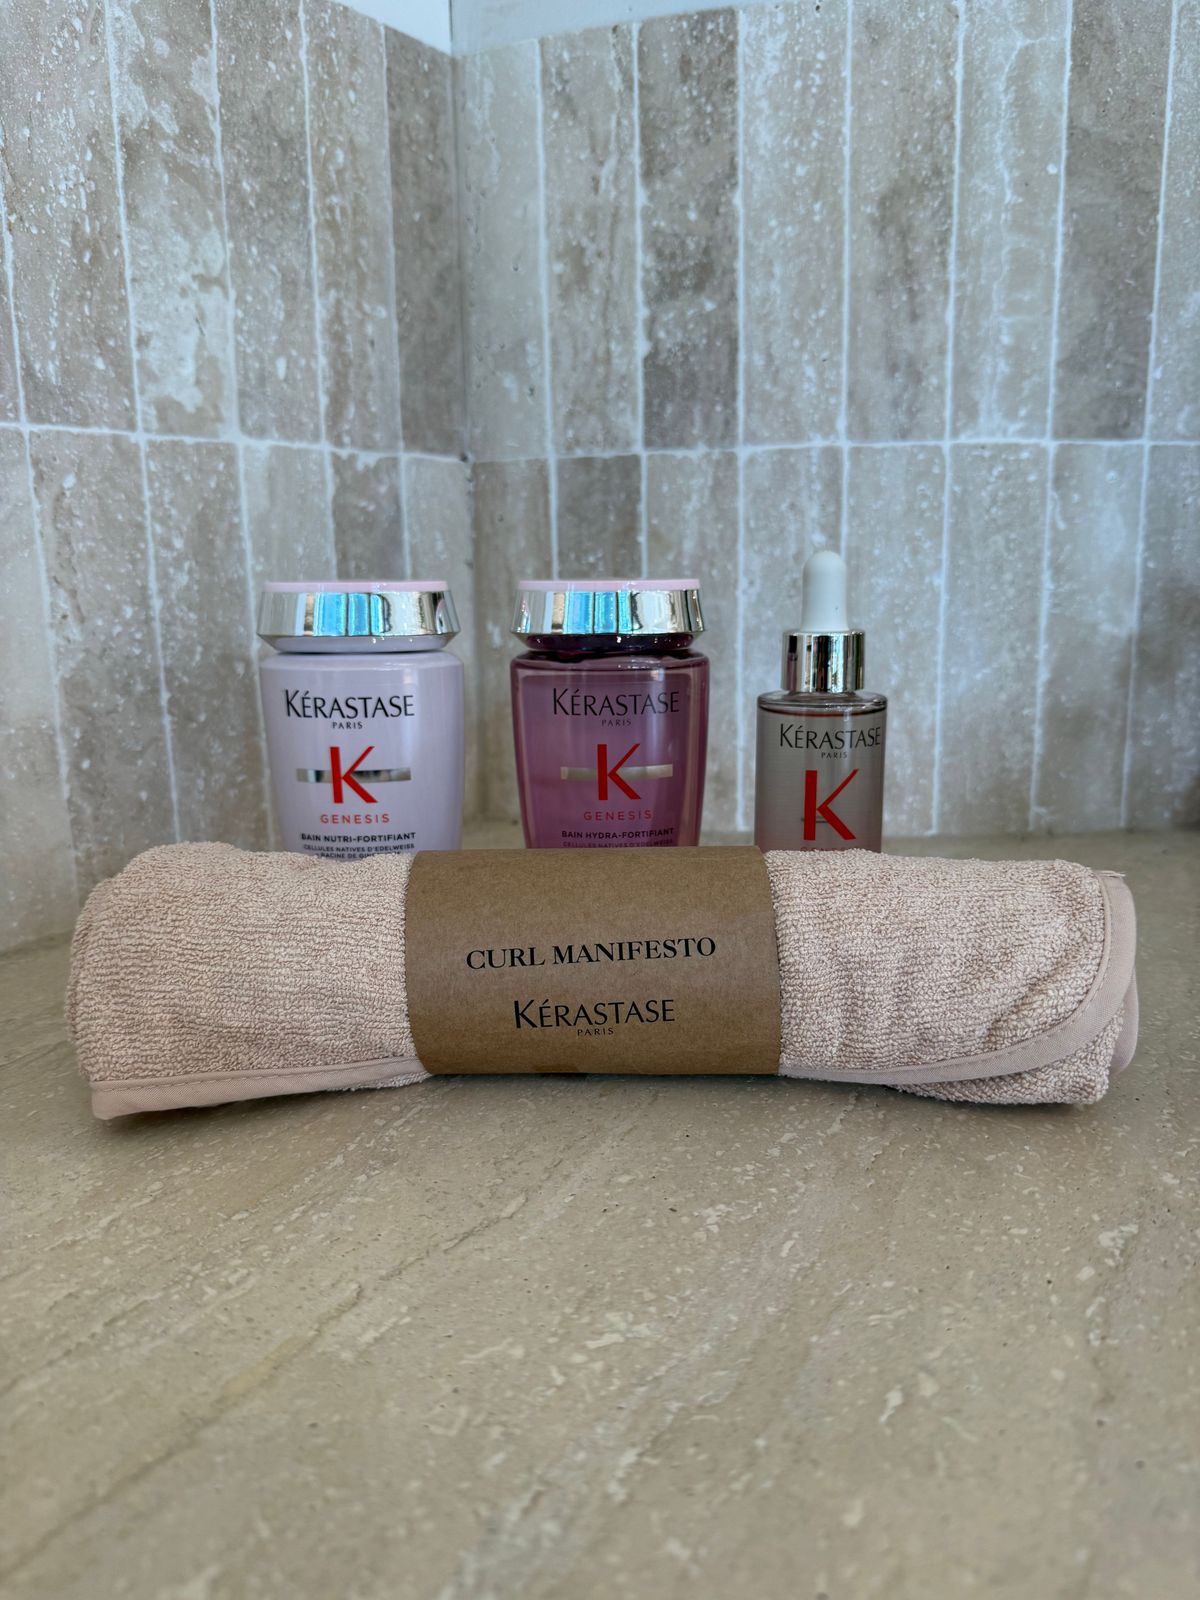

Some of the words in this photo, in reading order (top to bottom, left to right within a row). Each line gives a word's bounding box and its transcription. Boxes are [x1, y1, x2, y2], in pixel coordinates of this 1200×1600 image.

[284, 689, 415, 719] KÉRASTASE
[553, 687, 680, 717] KÉRASTASE
[332, 721, 363, 730] PARIS
[601, 719, 632, 728] PARIS
[780, 723, 881, 749] KÉRASTASE
[330, 746, 378, 803] K
[597, 743, 641, 801] K
[804, 770, 858, 840] K
[320, 813, 390, 824] GENESIS
[583, 810, 653, 821] GENESIS
[301, 833, 321, 841] BAIN
[324, 832, 416, 843] NUTRI-FORTIFIANT
[561, 830, 583, 838] BAIN
[586, 827, 674, 839] HYDRA-FORTIFIANT
[303, 844, 334, 852] CELLULES
[367, 843, 415, 852] D'EDELWEISS
[466, 946, 545, 970] CURL
[552, 936, 717, 965] MANIFESTO
[514, 998, 676, 1029] KÉRASTASE
[577, 1027, 614, 1036] PARIS
